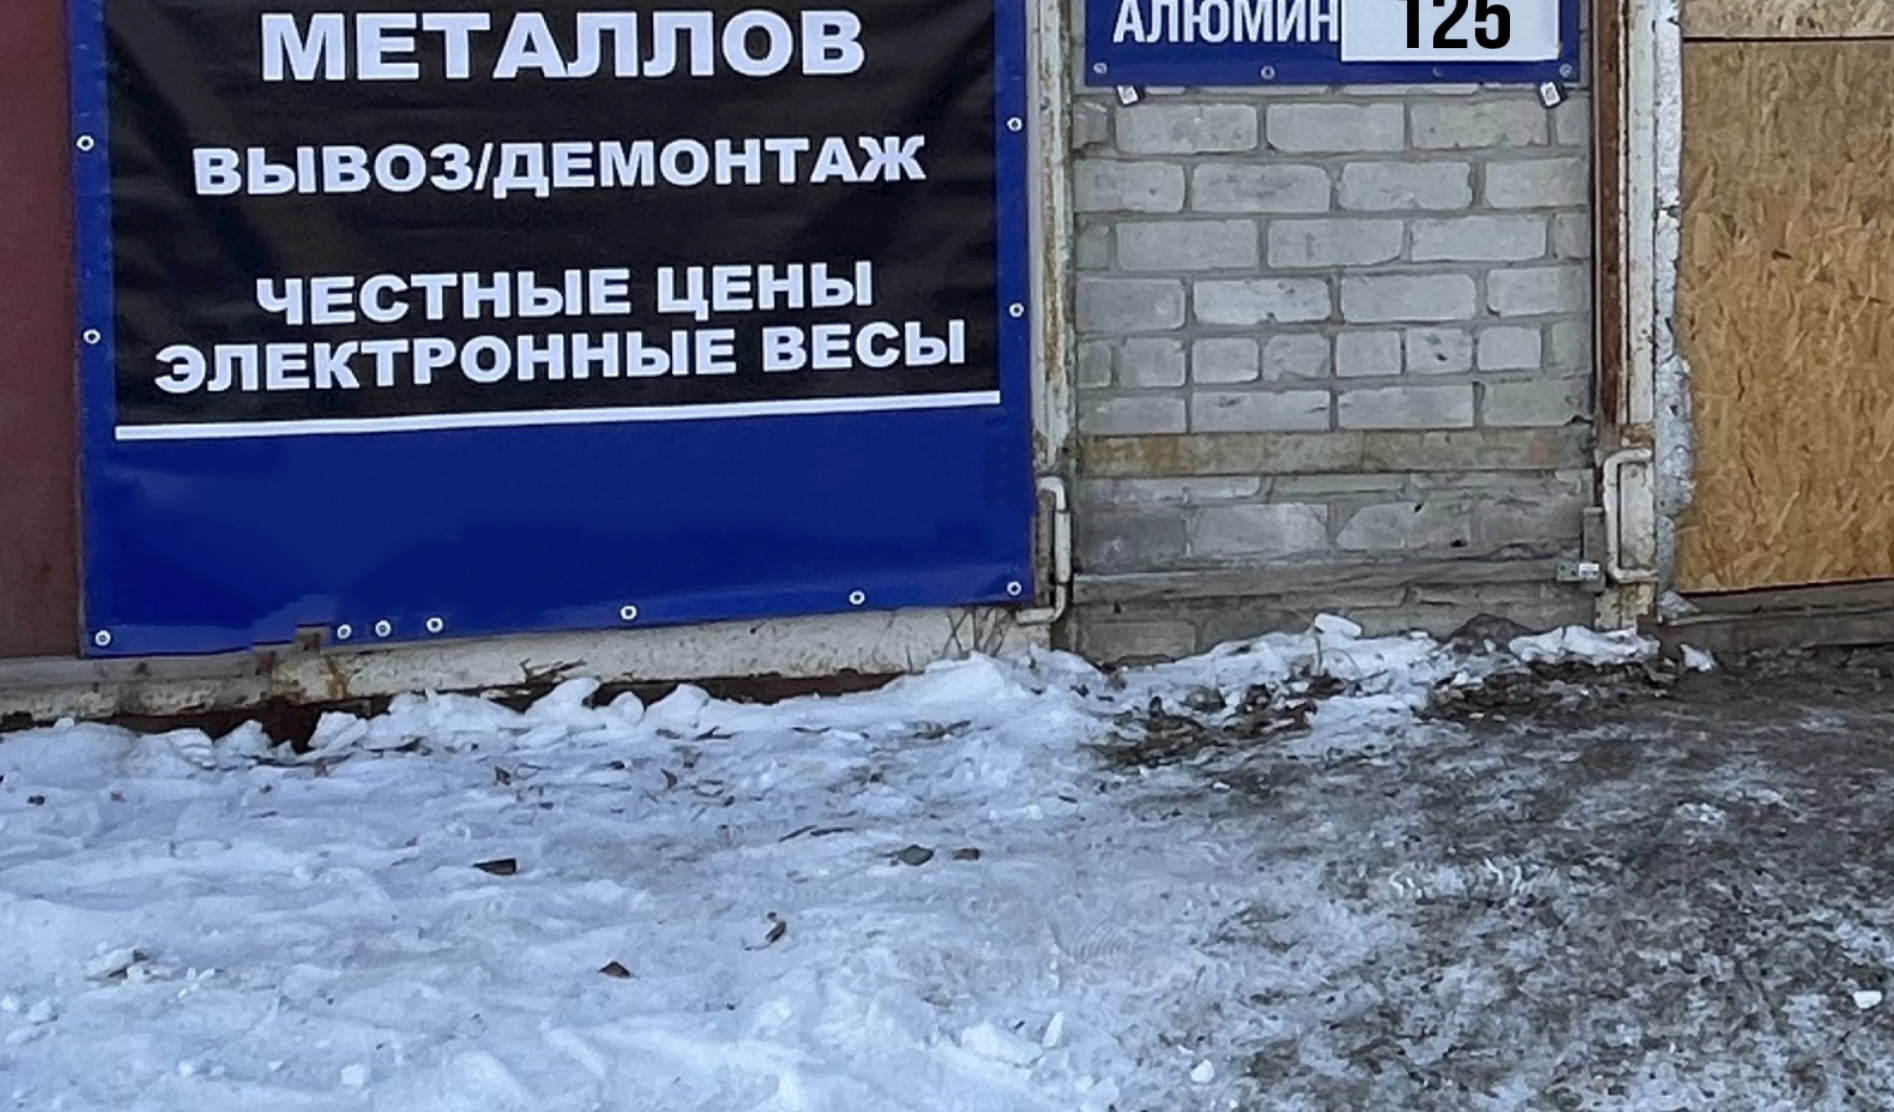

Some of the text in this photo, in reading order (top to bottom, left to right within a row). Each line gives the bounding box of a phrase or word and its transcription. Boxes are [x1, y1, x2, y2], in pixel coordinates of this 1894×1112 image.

[261, 10, 866, 81] МЕТАЛЛОВ
[192, 135, 926, 200] ВЫВОЗ/ДЕМОНТАЖ
[256, 261, 873, 326] ЧЕСТНЫЕ ЦЕНЫ
[154, 319, 966, 393] ЭЛЕКТРОННЫЕ ВЕСЫ
